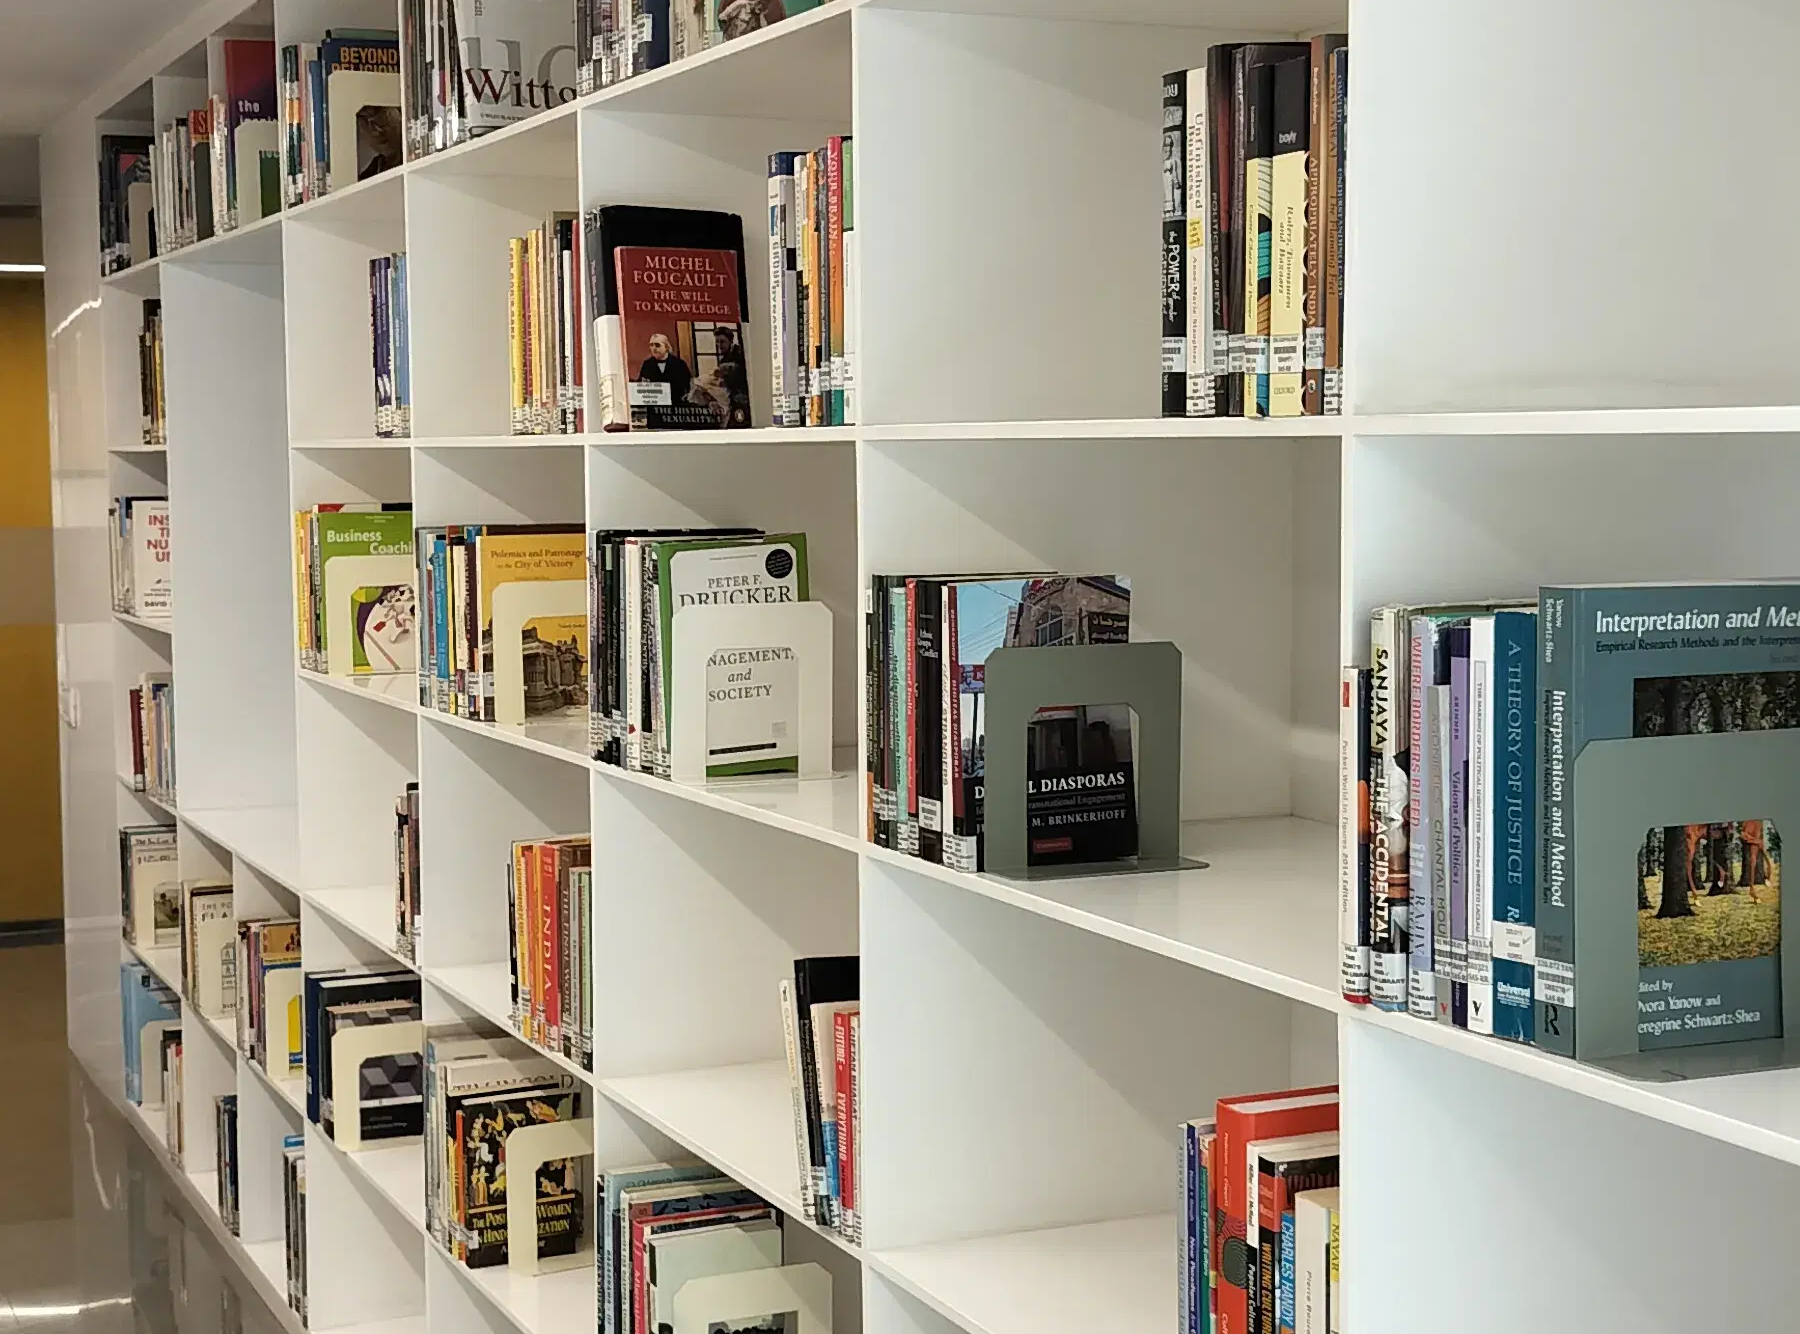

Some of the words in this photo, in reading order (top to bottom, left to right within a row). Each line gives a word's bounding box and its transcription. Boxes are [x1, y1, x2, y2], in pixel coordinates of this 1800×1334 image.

[340, 46, 398, 64] BEYOND
[237, 99, 260, 113] the
[1193, 113, 1204, 210] Unfinished
[1211, 192, 1219, 253] POLITICS
[1309, 157, 1319, 279] APPROPRIATELY
[646, 254, 715, 271] MICHEL
[1168, 244, 1181, 292] POWER
[1212, 255, 1219, 273] OF
[633, 270, 728, 288] FOUCAULT
[635, 301, 651, 312] TO
[654, 301, 732, 316] KNOWLEDGE
[651, 289, 677, 302] THE
[681, 289, 712, 303] WILL
[326, 529, 382, 543] Business
[514, 560, 532, 571] City
[534, 559, 542, 569] of
[545, 559, 574, 571] Victory
[528, 548, 543, 558] and
[679, 584, 794, 608] DRUCKER
[707, 574, 751, 589] PETER
[753, 574, 763, 585] F.
[1555, 598, 1564, 628] Yanow
[1596, 608, 1720, 638] Interpretation
[1725, 606, 1762, 631] and
[706, 647, 796, 667] NAGEMENT,
[1508, 639, 1522, 657] A
[1596, 638, 1636, 655] Empirical
[1638, 638, 1678, 651] Research
[1680, 636, 1720, 649] Methods
[1722, 636, 1740, 647] and
[1742, 635, 1758, 647] the
[727, 667, 752, 683] and
[1410, 636, 1423, 697] WHERE
[708, 684, 773, 703] SOCIETY
[1375, 647, 1389, 746] SANJAYA
[1507, 662, 1522, 756] THEORY
[1410, 700, 1422, 776] BORDERS
[1550, 690, 1566, 801] Interpretation
[1041, 771, 1126, 793] DIASPORAS
[1507, 761, 1522, 791] OF
[1028, 797, 1075, 810] ransnational
[1077, 793, 1126, 807] Engagement
[1452, 771, 1461, 813] Visions
[1048, 808, 1127, 826] BRINKERHOFF
[1552, 807, 1566, 838] and
[1507, 795, 1523, 885] JUSTICE
[1434, 819, 1445, 892] CHANTAL
[1452, 834, 1461, 877] Politics
[1375, 821, 1390, 942] ACCIDENTAL
[1550, 843, 1567, 908] Method
[543, 904, 553, 990] INDIA
[1638, 979, 1660, 993] dited
[1661, 978, 1674, 993] by
[1667, 996, 1702, 1011] Yanow
[1705, 994, 1722, 1007] and
[1637, 1016, 1683, 1036] eregrine
[1684, 1008, 1761, 1029] Schwartz-Shea
[836, 1091, 848, 1161] EVERYTHING
[1280, 1221, 1295, 1277] CHARLES
[1261, 1242, 1273, 1287] WRITING
[1248, 1263, 1257, 1297] Popular
[1248, 1299, 1257, 1332] Culture
[1280, 1279, 1295, 1326] HANDY
